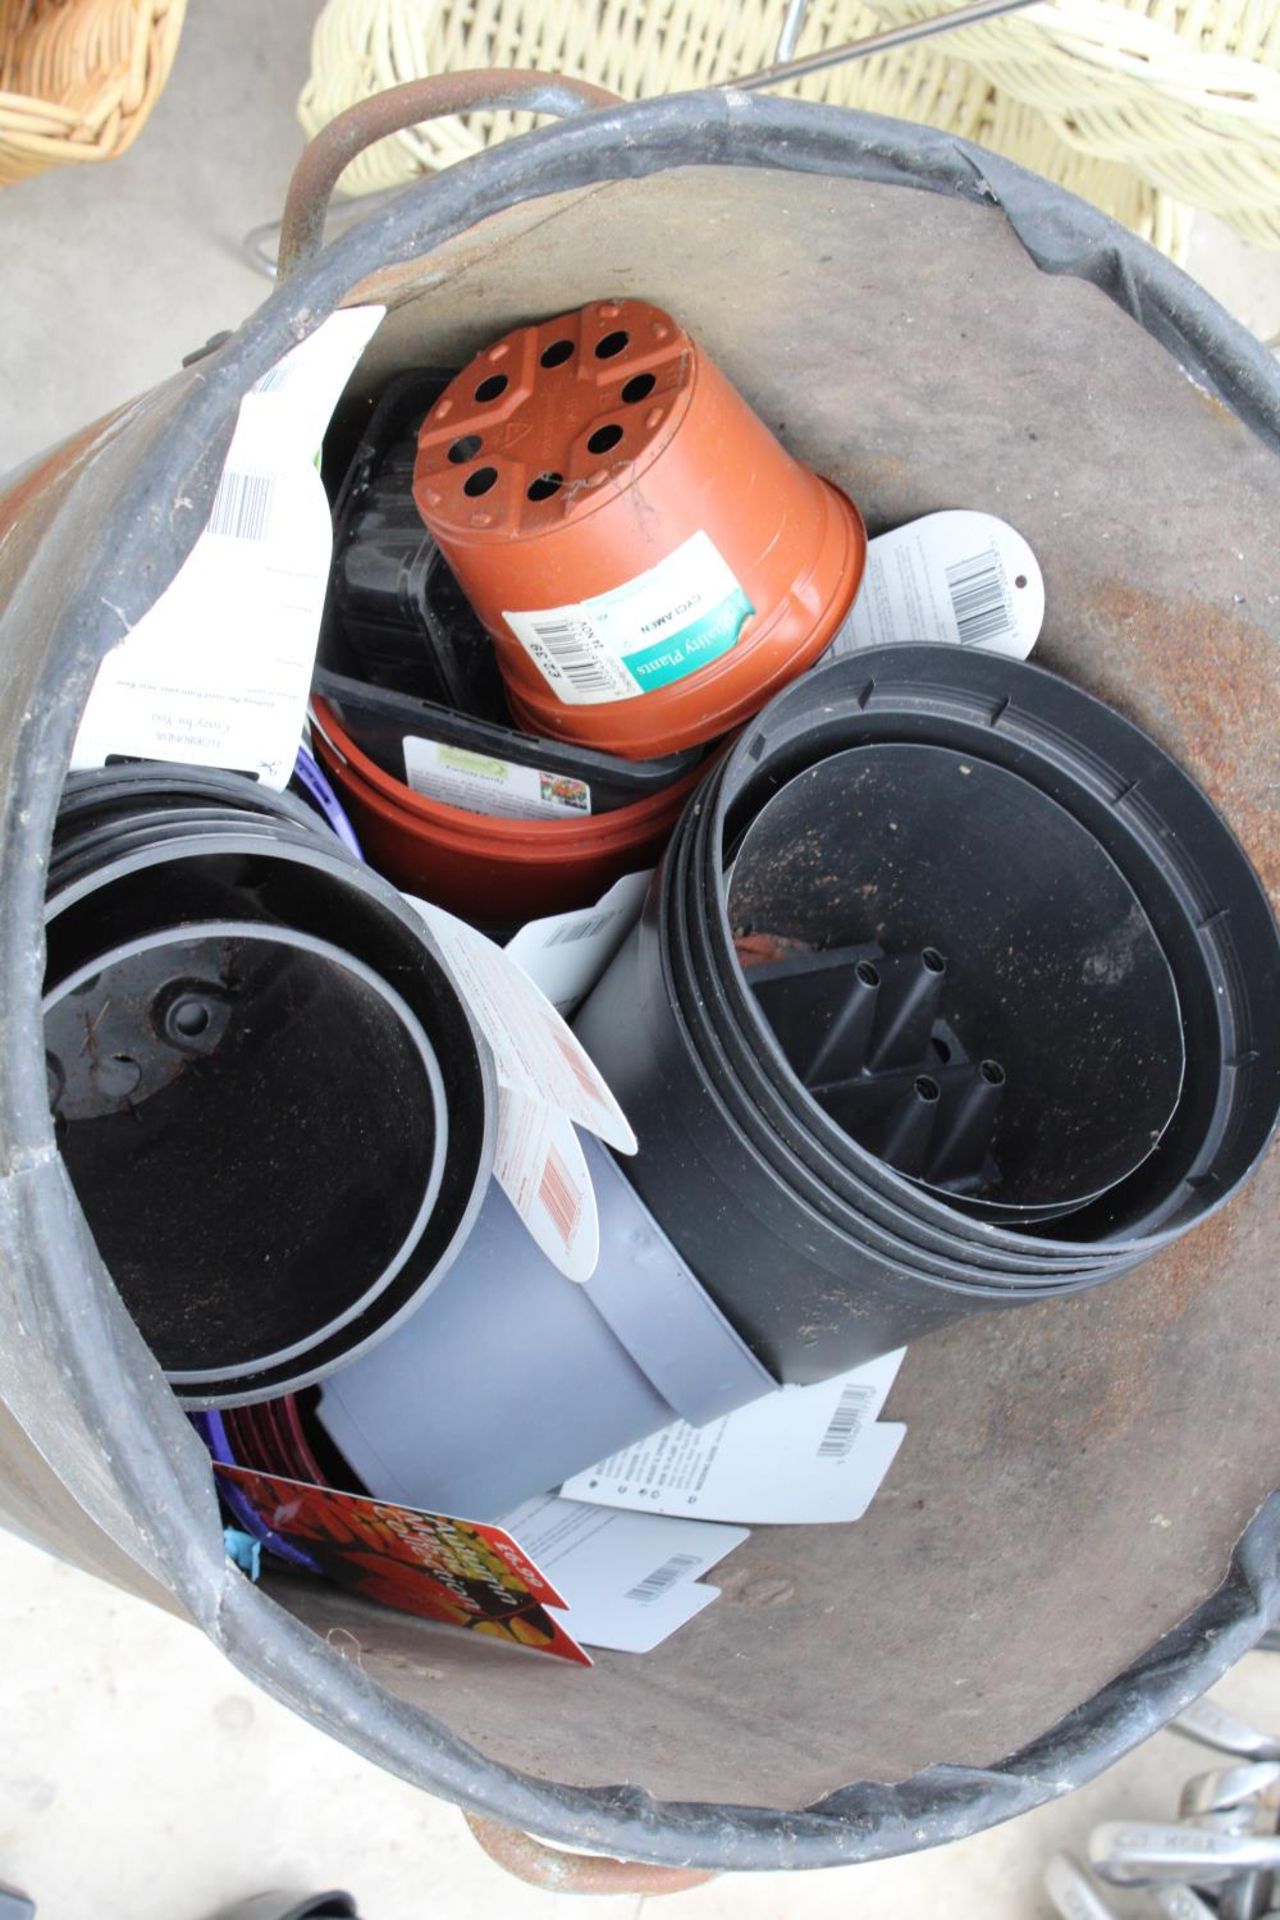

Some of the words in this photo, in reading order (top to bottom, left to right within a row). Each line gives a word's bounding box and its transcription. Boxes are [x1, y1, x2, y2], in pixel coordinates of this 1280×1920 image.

[640, 593, 701, 634] CYCLAMEN
[637, 648, 685, 675] Plants
[421, 1514, 518, 1606] Autumn
[494, 1541, 544, 1588] £6.99
